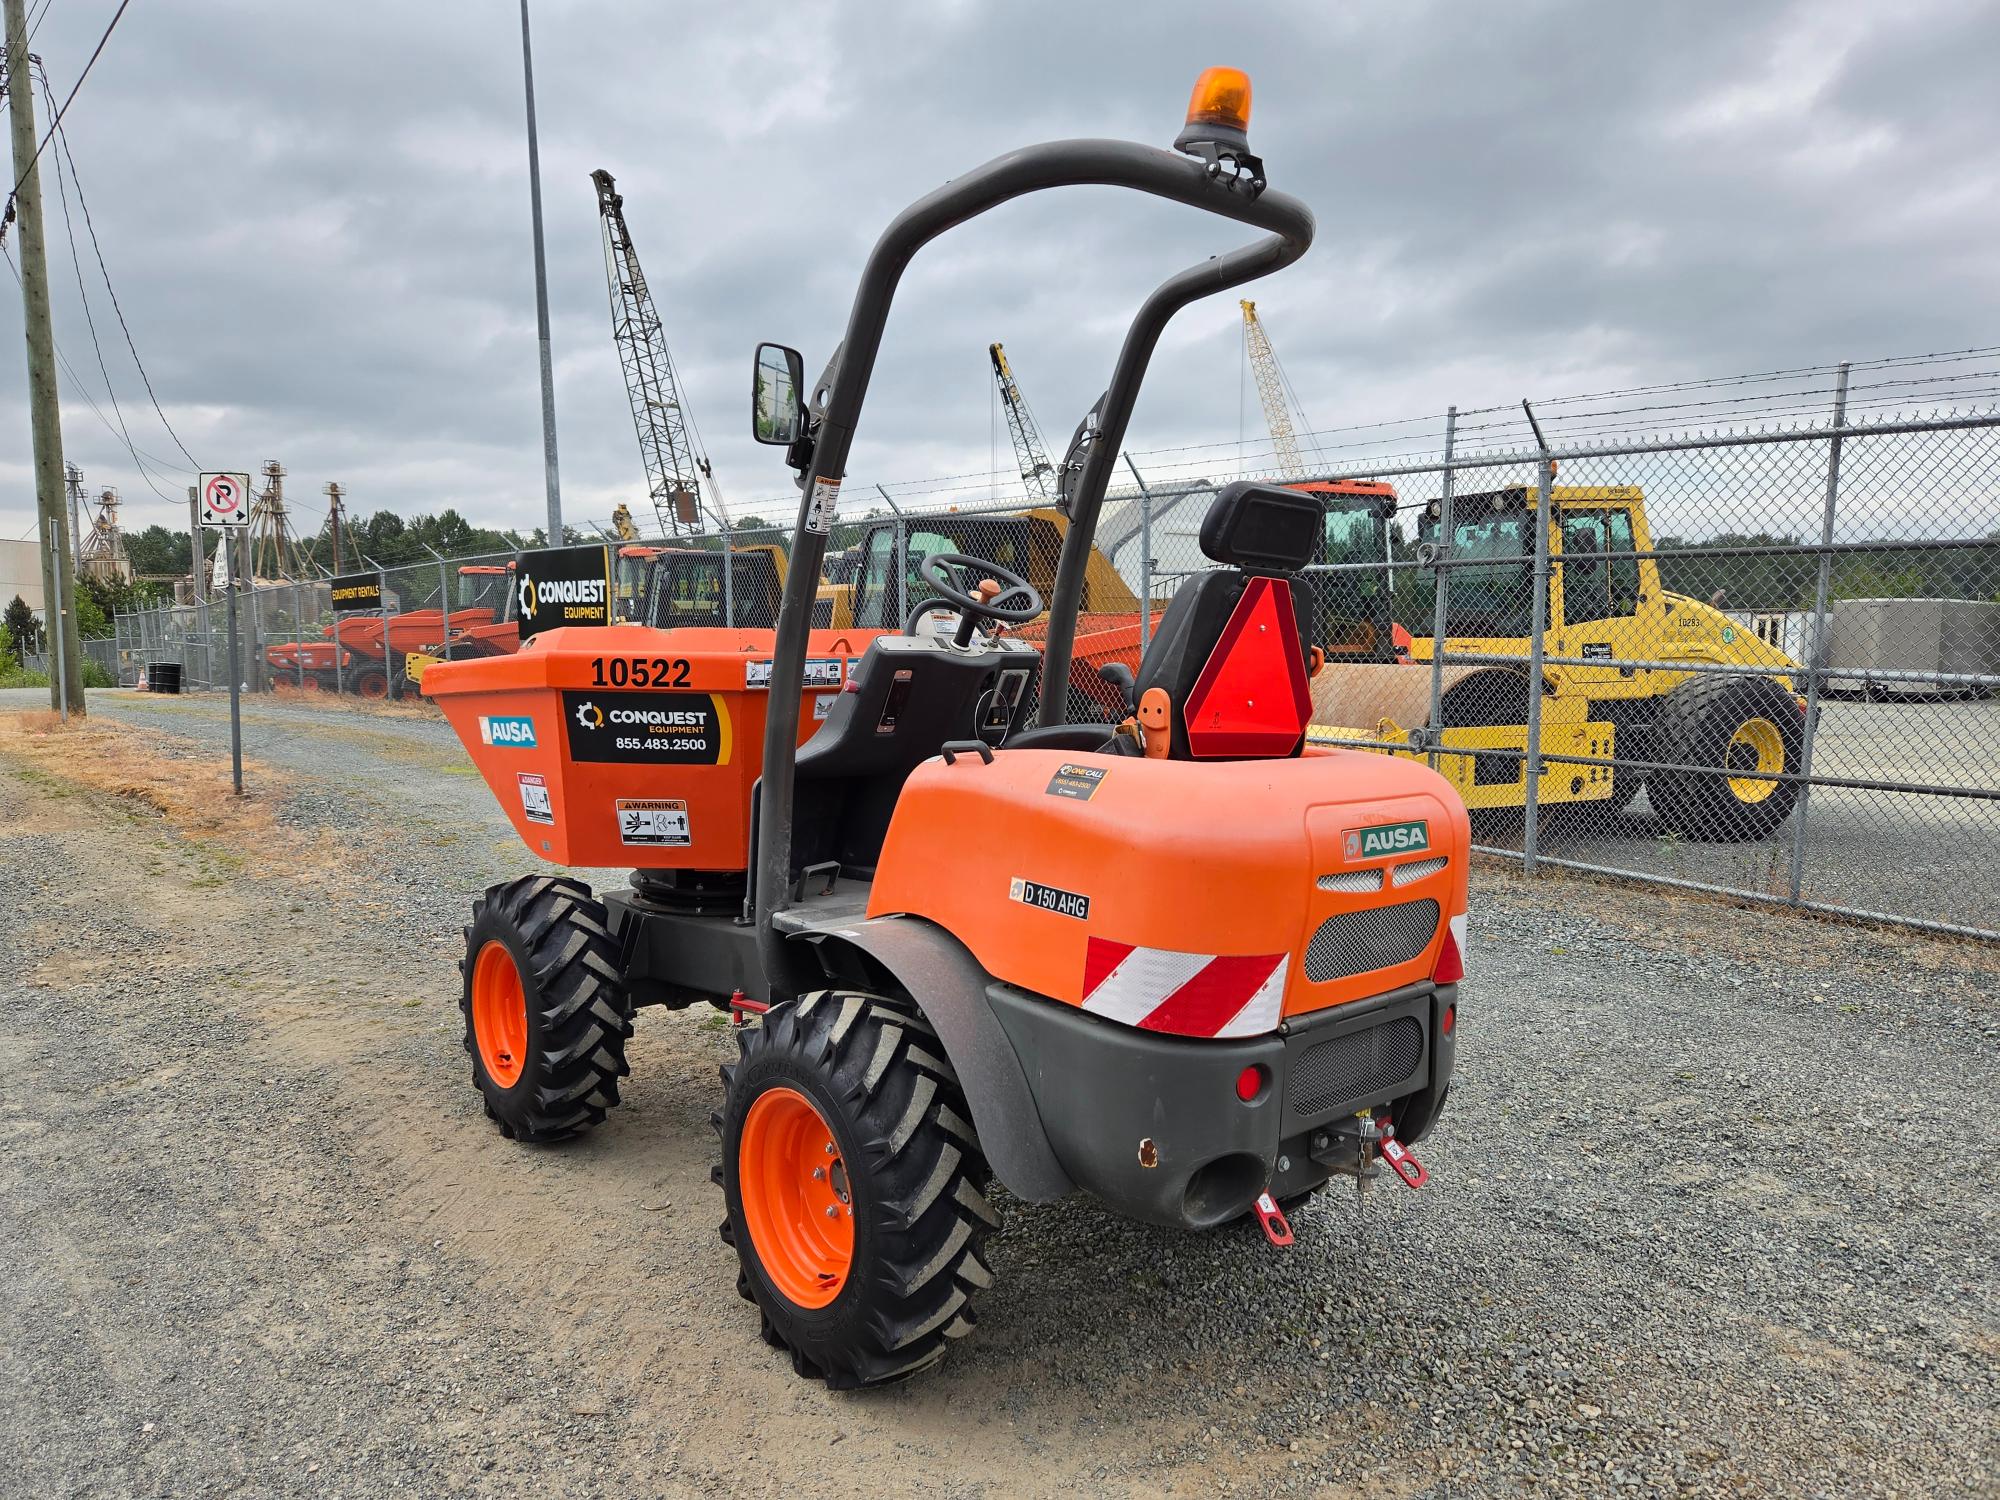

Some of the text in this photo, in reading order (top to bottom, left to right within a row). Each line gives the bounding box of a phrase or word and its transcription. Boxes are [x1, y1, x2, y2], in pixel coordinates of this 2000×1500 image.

[332, 585, 380, 600] EQUIPMENT RENTALS
[538, 579, 606, 604] CONQUEST
[564, 607, 604, 619] EQUIPMENT
[1678, 618, 1700, 627] 10283
[591, 657, 692, 688] 10522
[609, 709, 707, 726] CONQUEST
[492, 721, 535, 742] AUSA
[649, 725, 705, 734] EQUIPMENT
[616, 737, 707, 750] 855.483.2500
[1071, 767, 1103, 779] ONE CALL
[632, 802, 679, 810] WARNING
[1364, 827, 1426, 852] AUSA
[1025, 884, 1086, 917] D 150 AHG
